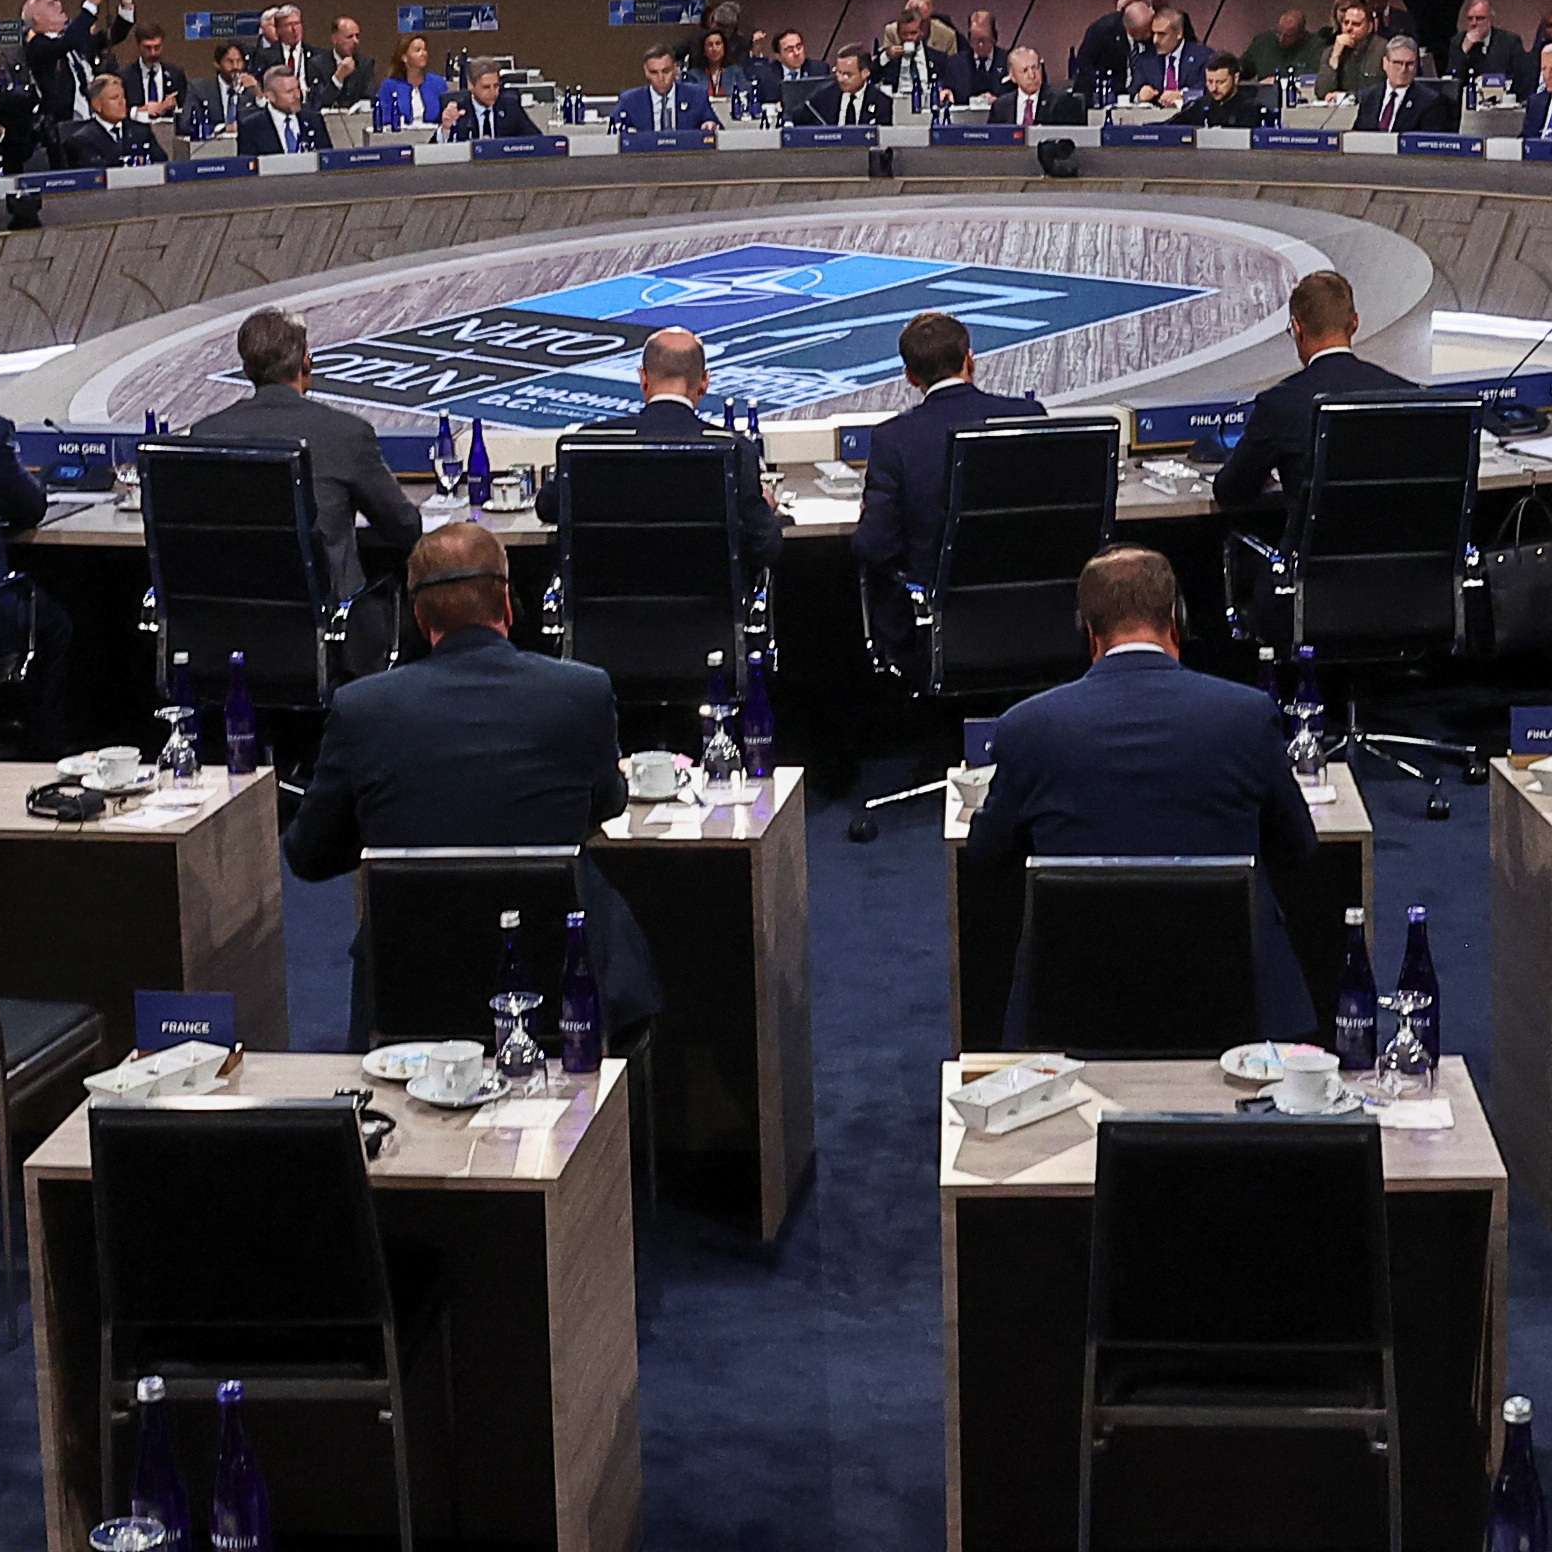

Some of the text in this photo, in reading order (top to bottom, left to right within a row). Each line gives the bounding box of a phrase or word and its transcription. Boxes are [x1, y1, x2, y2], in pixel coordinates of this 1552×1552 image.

[417, 316, 628, 357] NATO
[310, 353, 497, 395] OTAN
[161, 1021, 210, 1036] FRANCE
